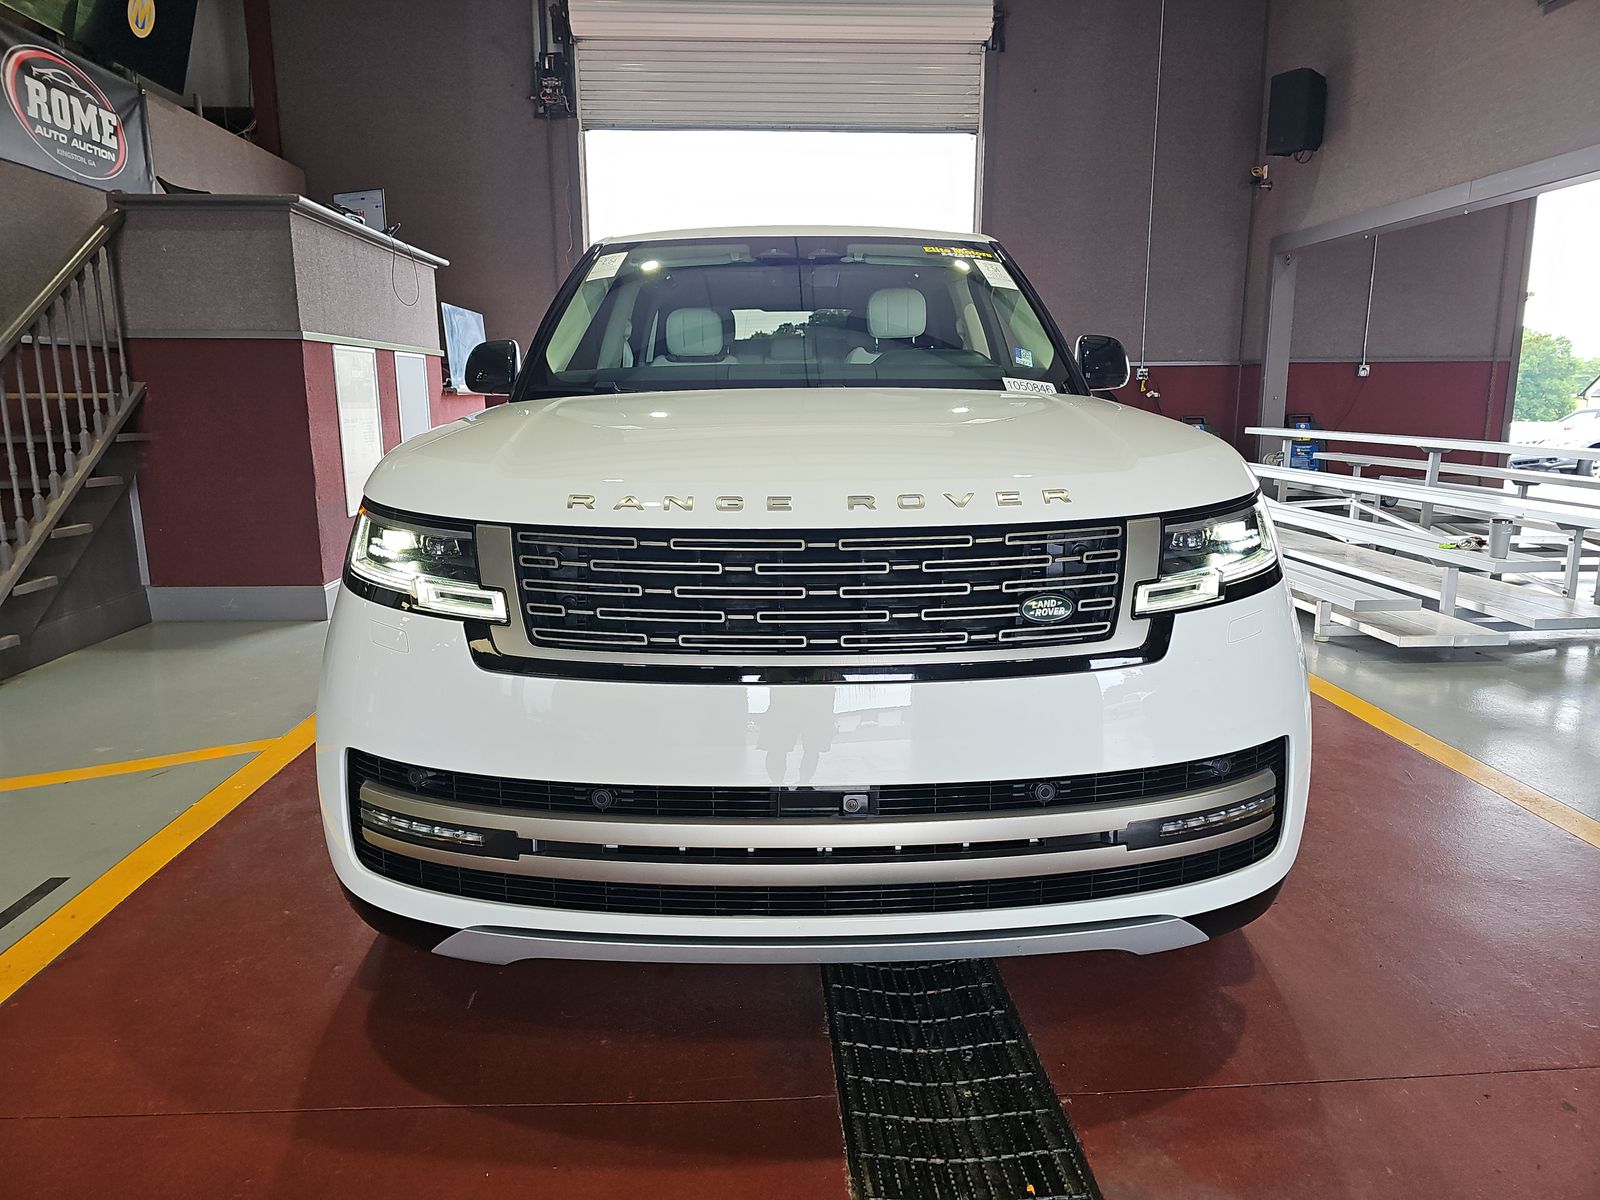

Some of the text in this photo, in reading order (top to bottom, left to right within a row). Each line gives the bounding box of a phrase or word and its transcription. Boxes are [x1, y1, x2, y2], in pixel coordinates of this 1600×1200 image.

[24, 74, 118, 150] ROME
[34, 124, 116, 162] AUTO AUCTION
[1006, 380, 1054, 394] 1050846
[566, 487, 1073, 512] RANGE ROVER
[1031, 599, 1057, 609] LAND
[1034, 606, 1066, 617] ROVER
